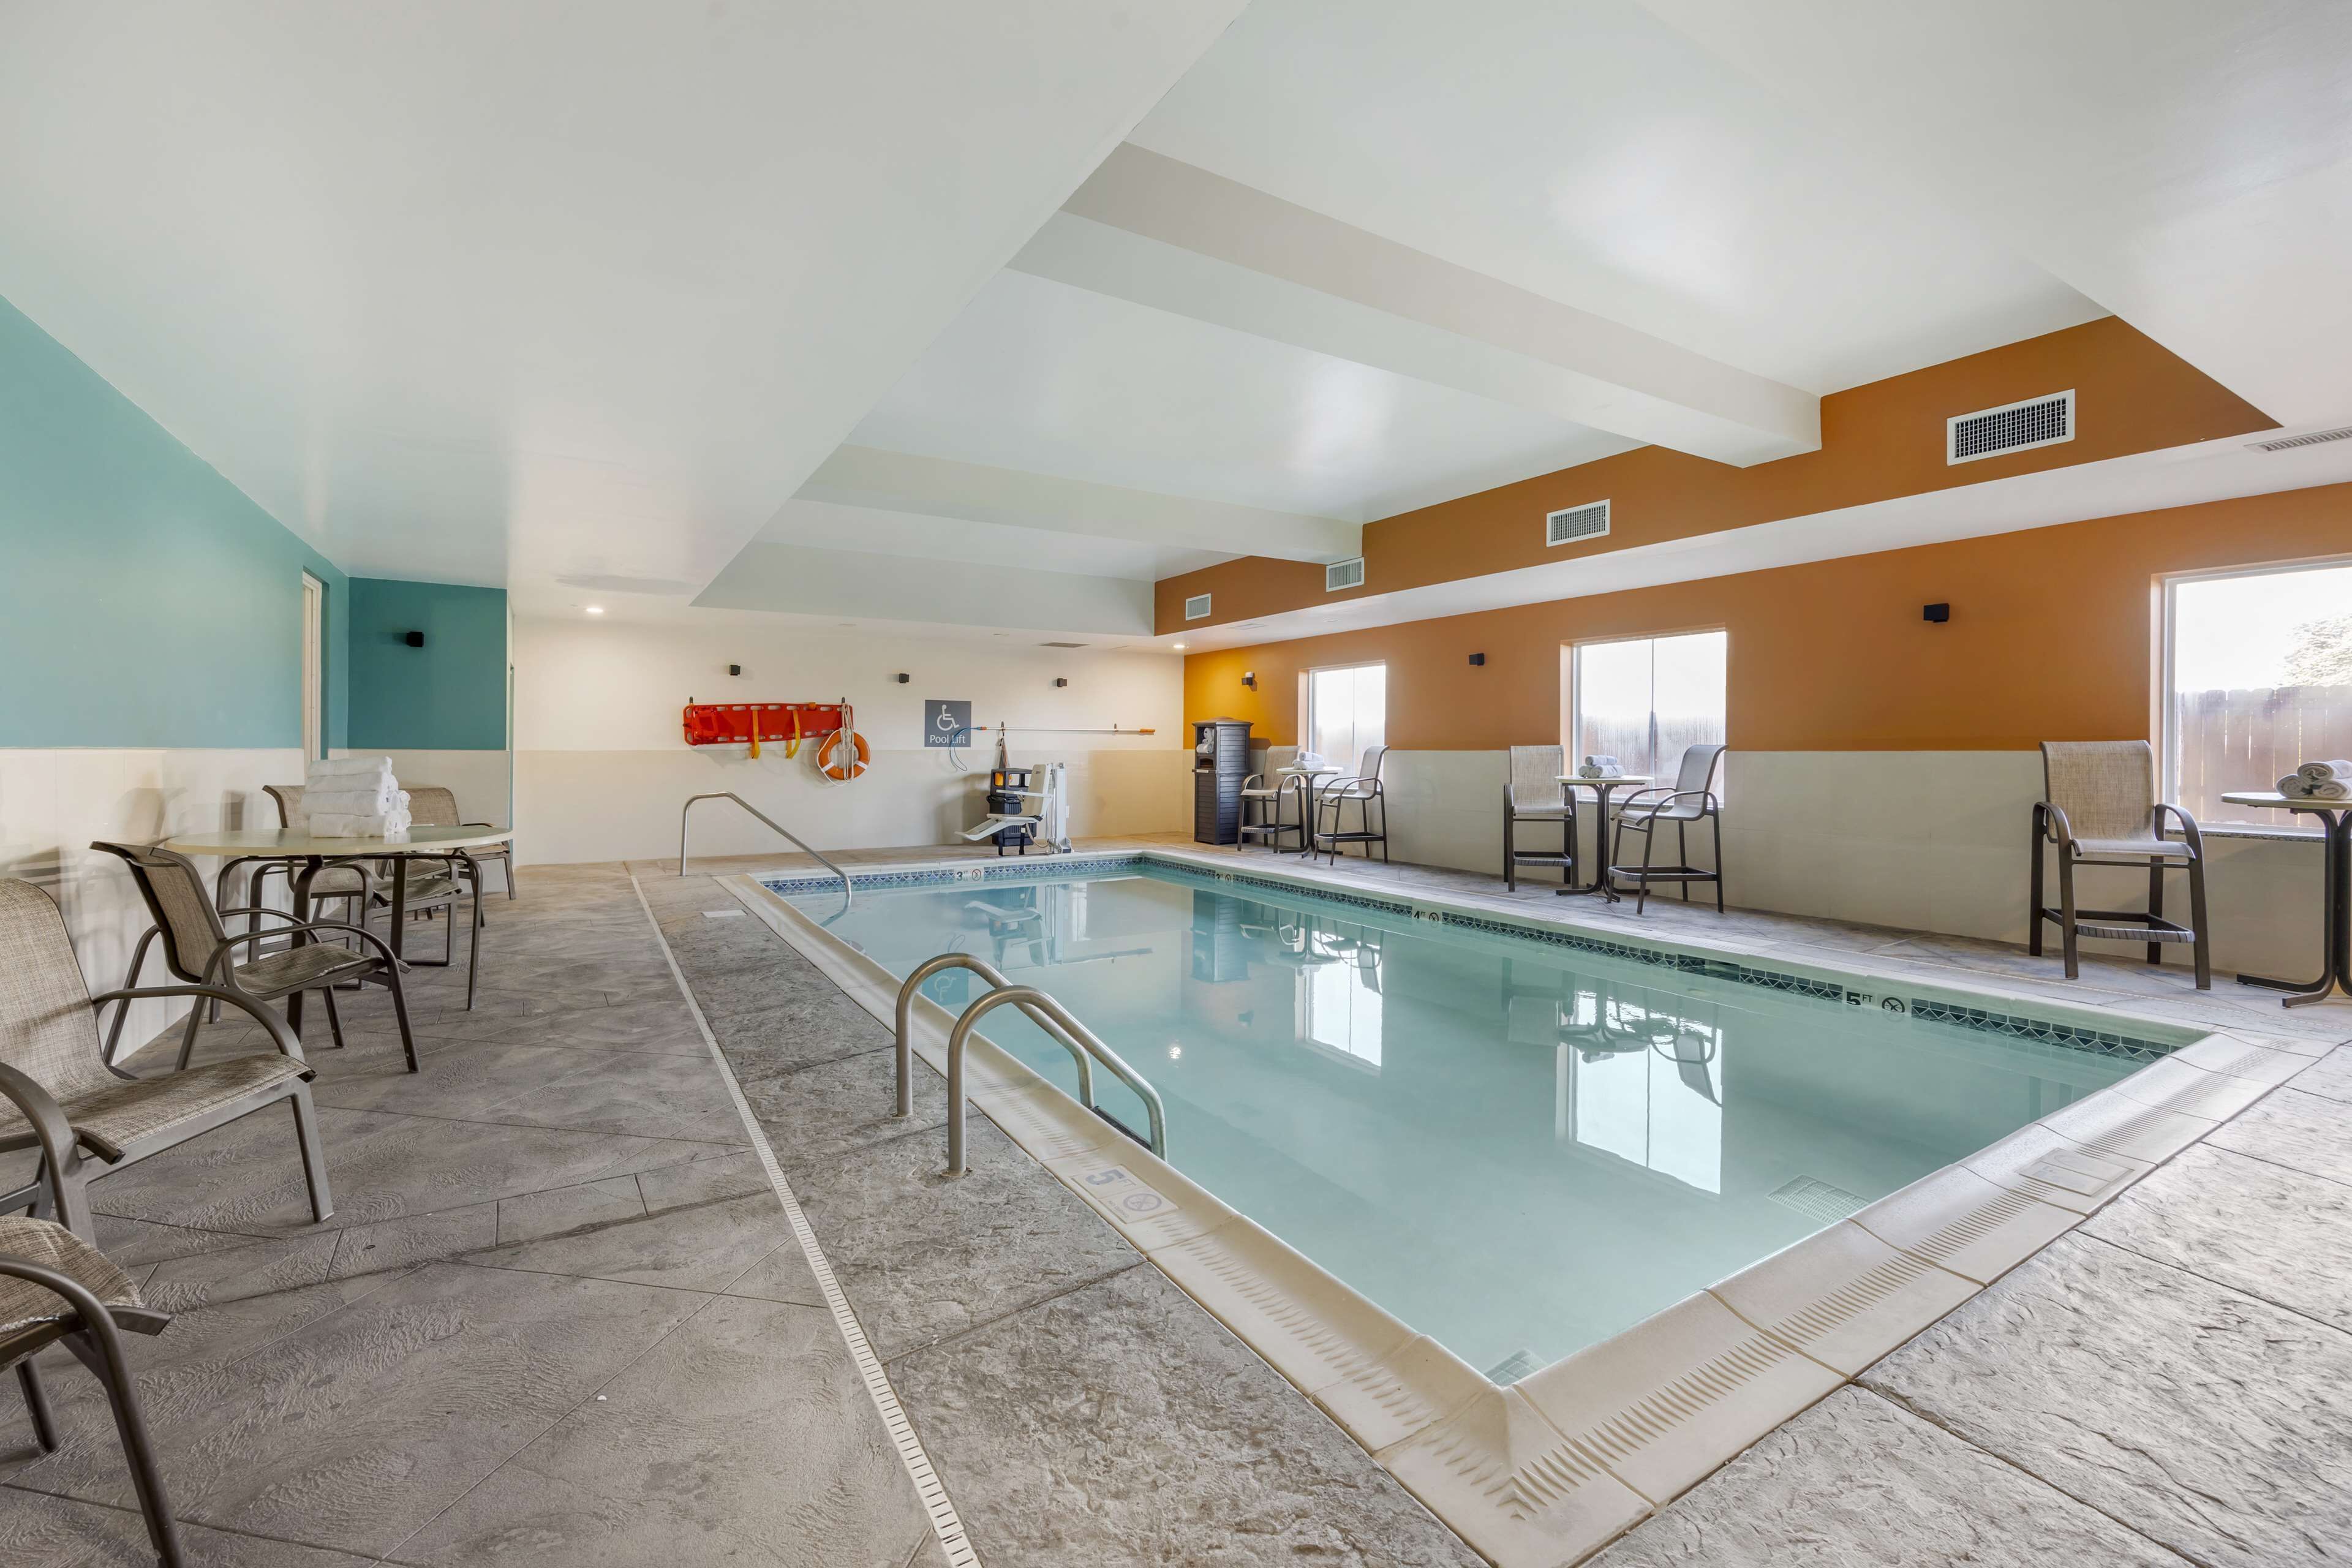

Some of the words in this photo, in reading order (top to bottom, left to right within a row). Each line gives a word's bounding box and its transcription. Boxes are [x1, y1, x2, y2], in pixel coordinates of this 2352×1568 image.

[930, 734, 949, 744] Pool
[952, 734, 966, 744] Lift
[957, 871, 963, 881] 3
[1846, 991, 1861, 1005] 5
[1085, 1169, 1125, 1185] 5
